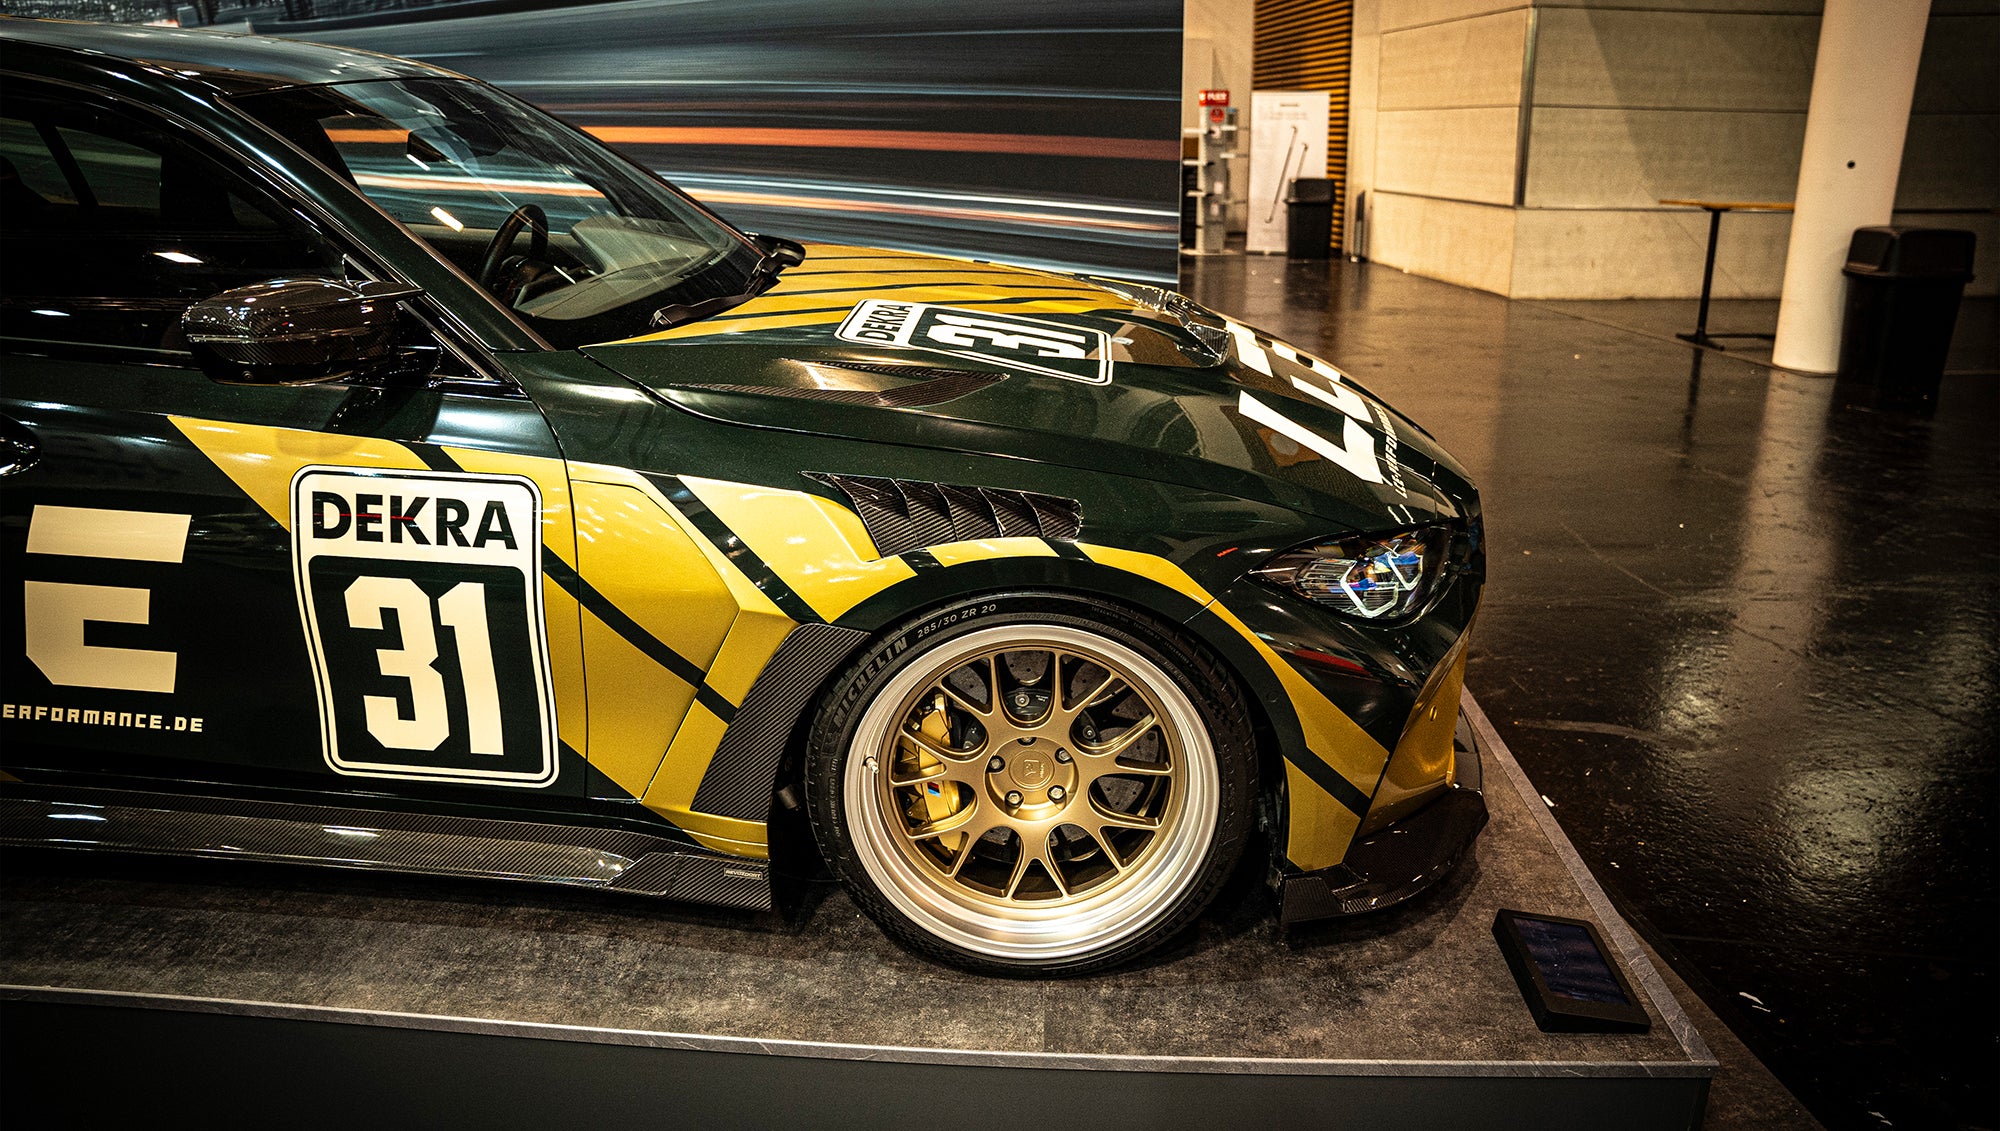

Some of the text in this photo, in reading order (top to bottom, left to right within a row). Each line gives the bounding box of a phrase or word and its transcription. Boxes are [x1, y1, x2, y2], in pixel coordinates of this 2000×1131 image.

[856, 304, 913, 342] DEKRA
[926, 313, 1087, 359] 31
[312, 491, 518, 550] DEKRA
[344, 576, 504, 756] 31
[833, 638, 910, 727] MICHELIN
[915, 614, 959, 639] 285/30
[959, 607, 978, 620] ZR
[980, 603, 998, 614] 20
[2, 703, 204, 733] ERFORMANCE.DE
